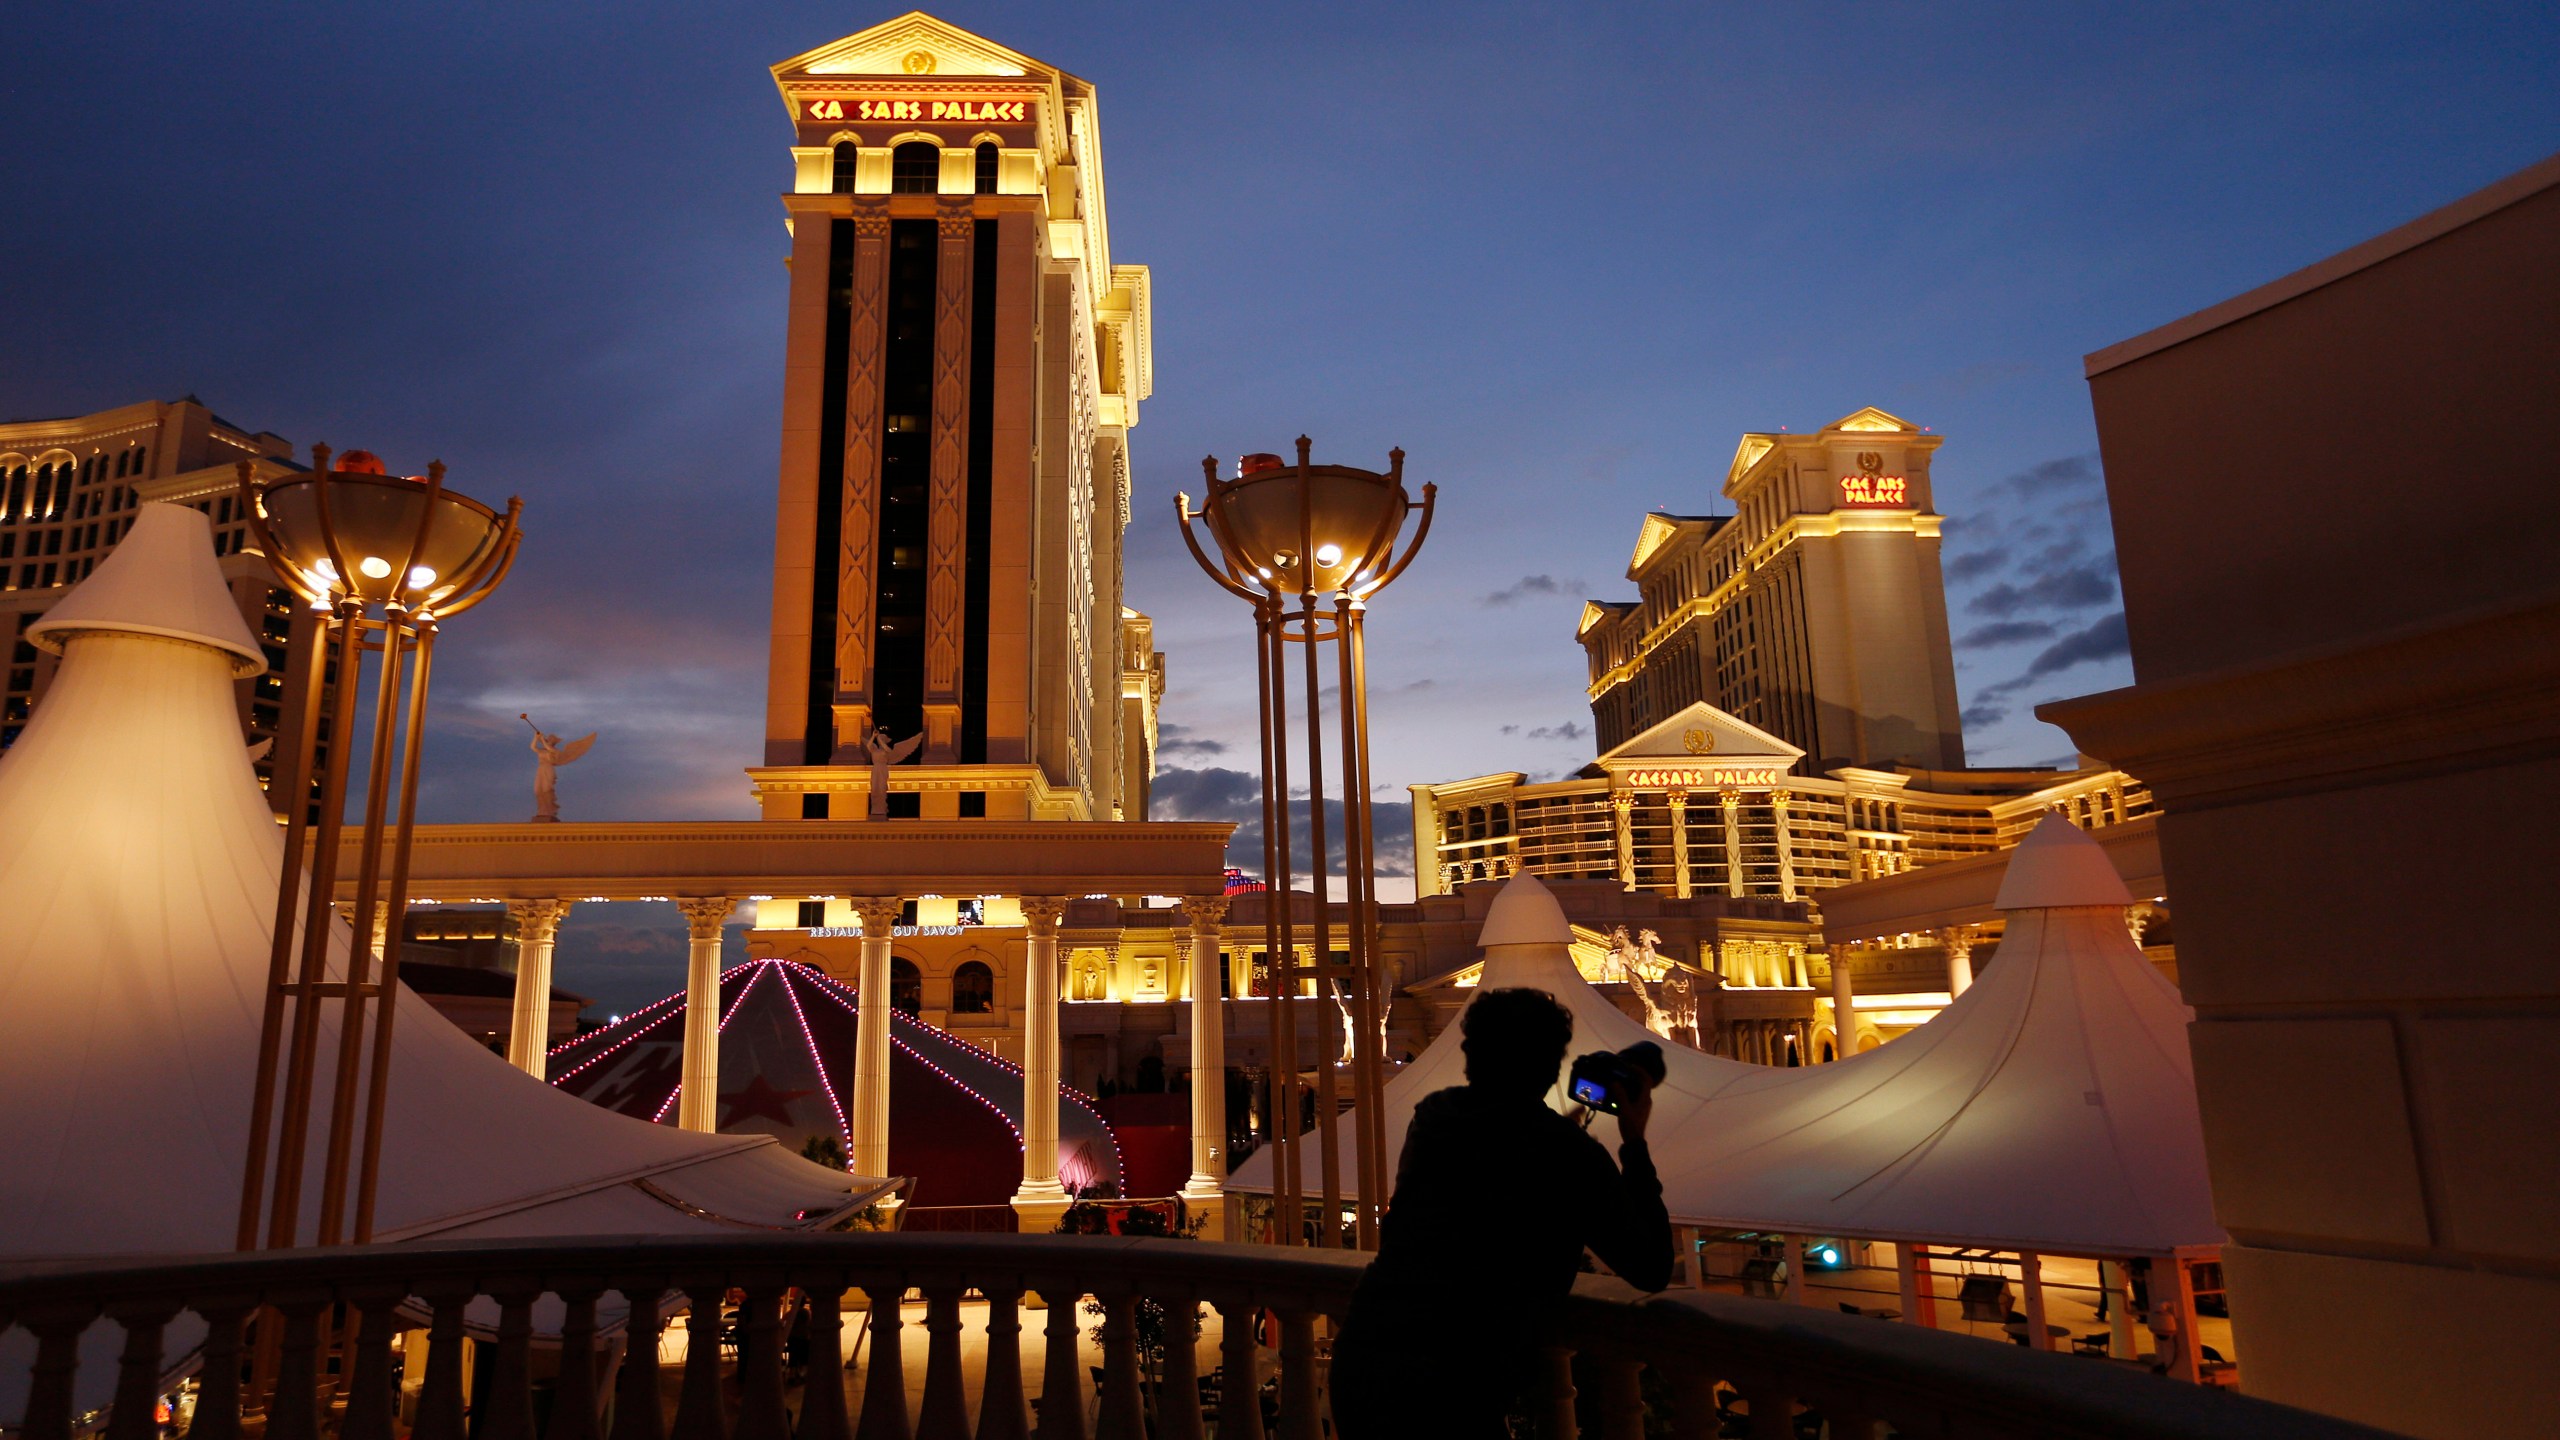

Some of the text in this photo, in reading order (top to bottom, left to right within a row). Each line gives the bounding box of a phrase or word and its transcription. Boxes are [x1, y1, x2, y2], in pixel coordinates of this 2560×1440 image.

[809, 99, 1025, 122] CASARS PALACE
[1840, 476, 1906, 490] CAEARS
[1845, 490, 1904, 503] PALACE
[1627, 770, 1777, 787] CAESARS PALACE
[892, 926, 921, 937] GUY
[922, 926, 965, 937] SAVOY
